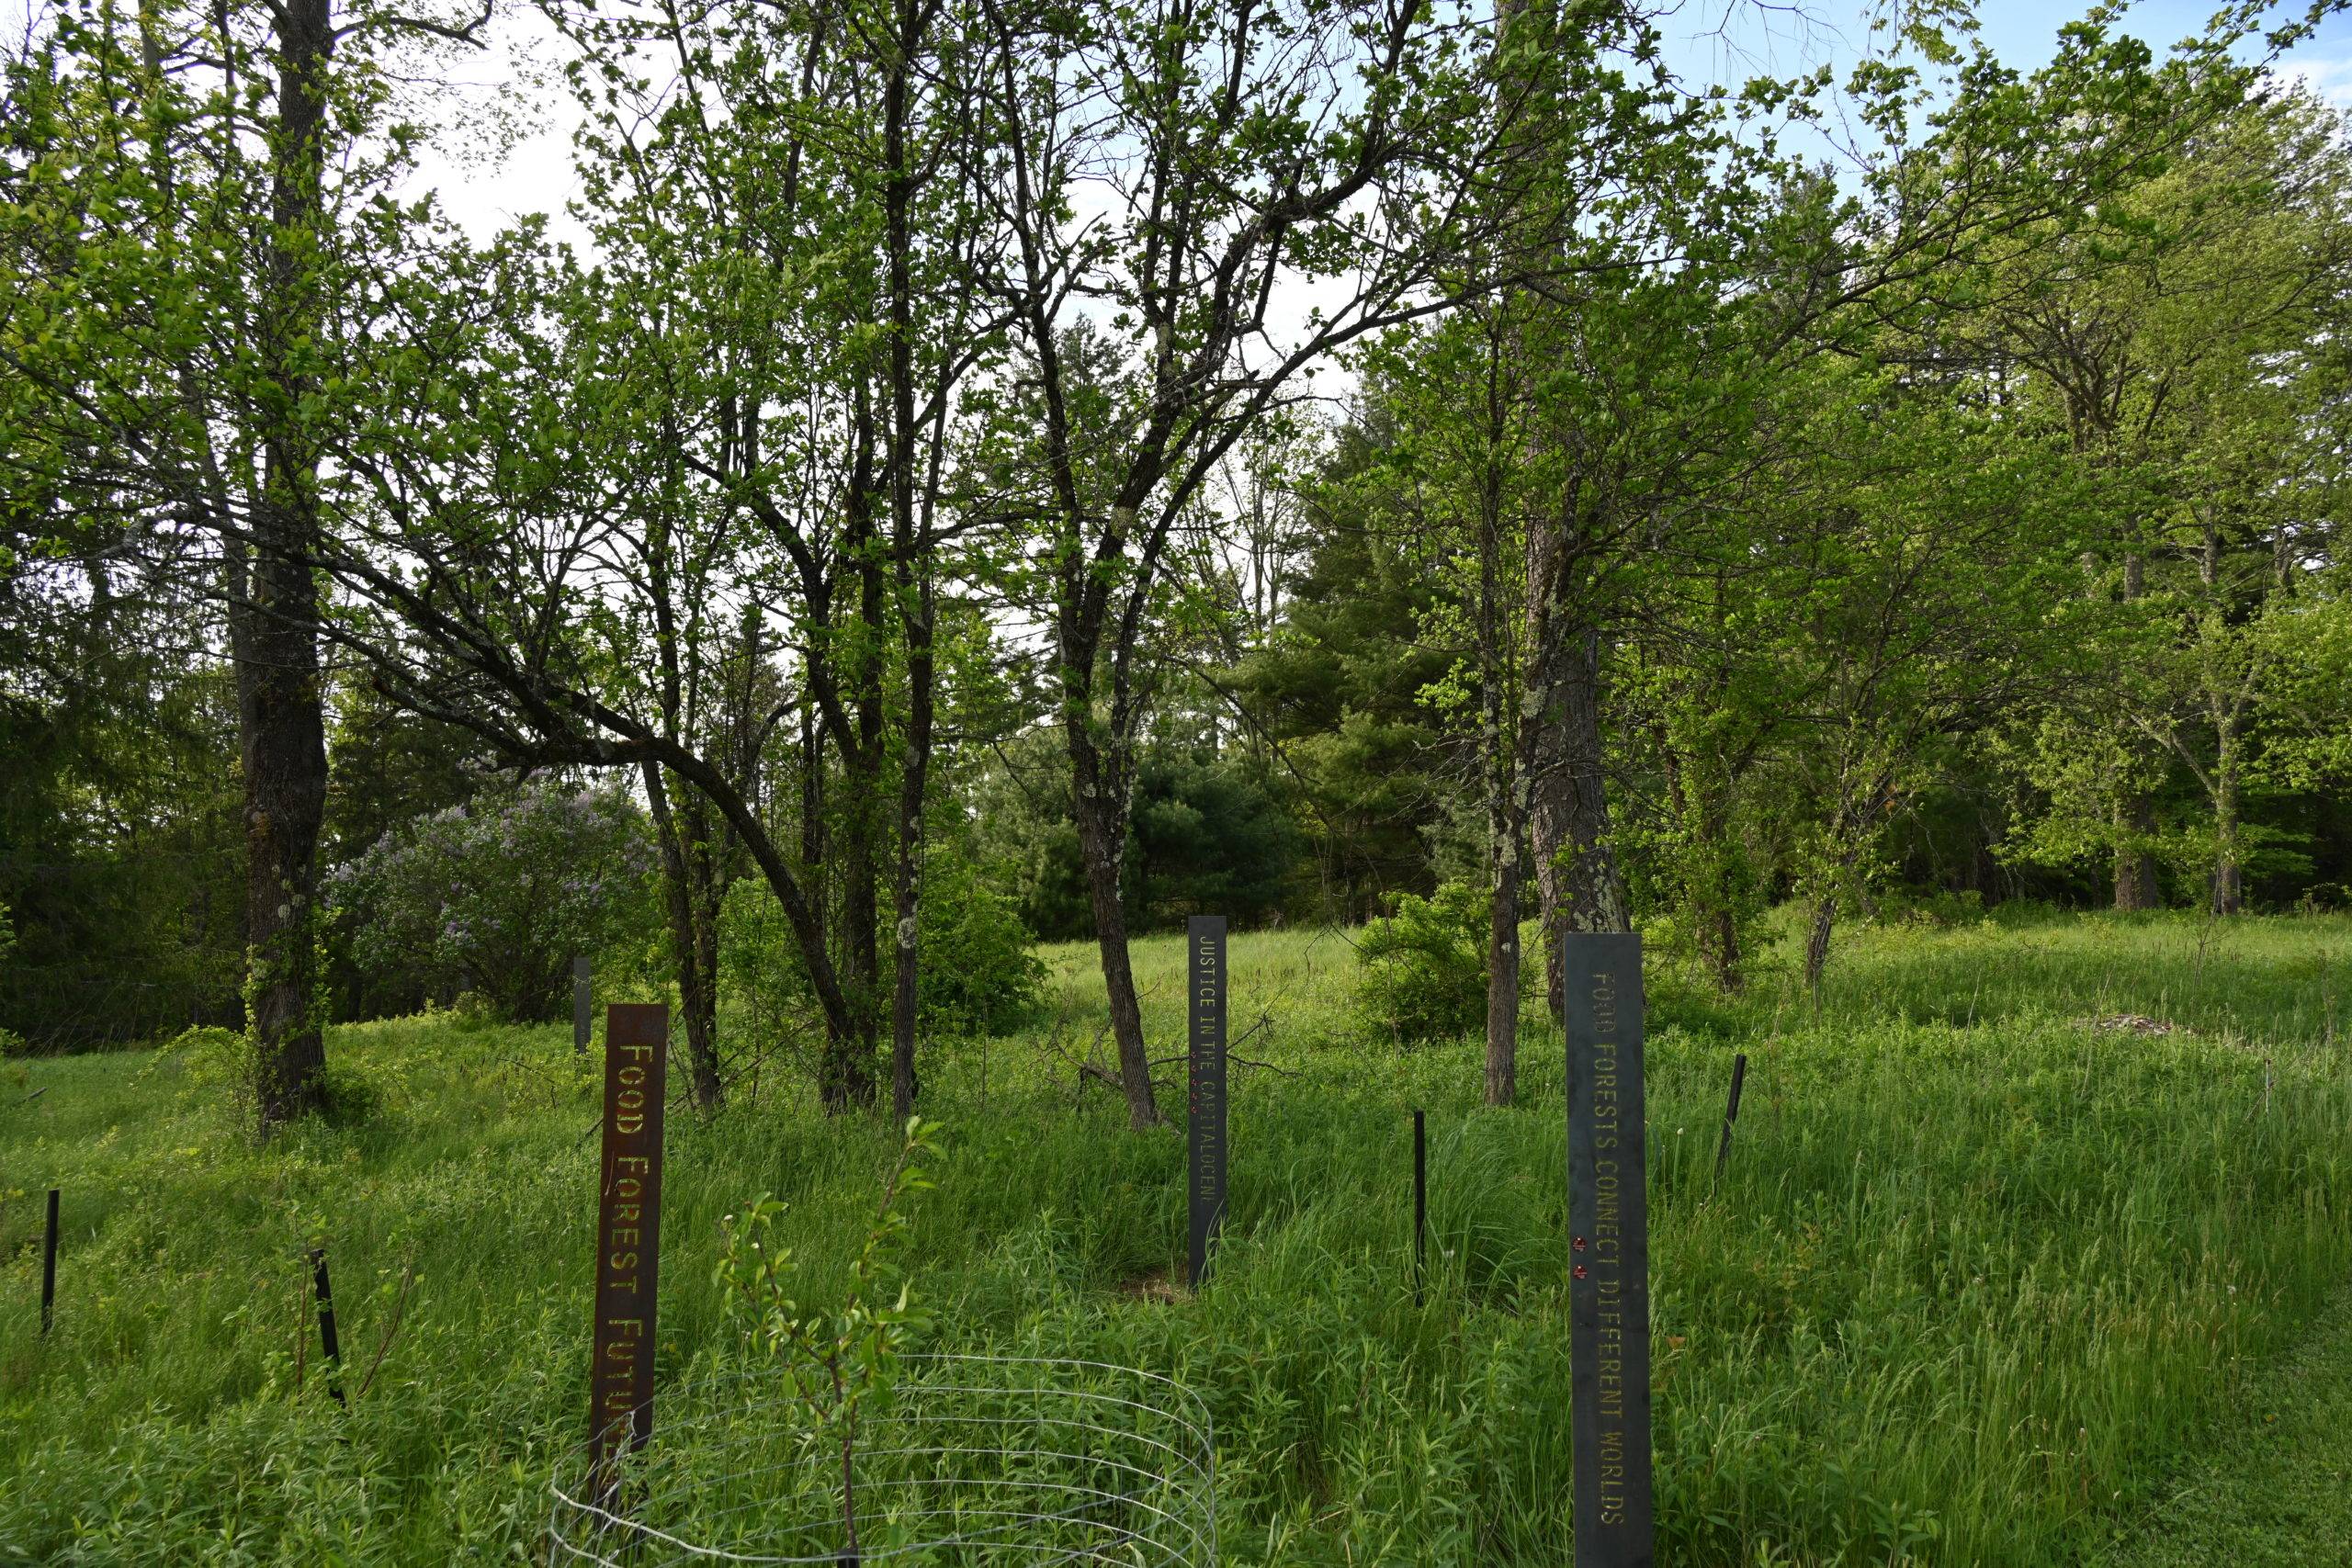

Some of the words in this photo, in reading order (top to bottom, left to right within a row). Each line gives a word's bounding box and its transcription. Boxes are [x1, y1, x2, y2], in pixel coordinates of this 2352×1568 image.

[1200, 936, 1216, 1008] JUSTICE
[1592, 974, 1616, 1034] FOOD
[1200, 1016, 1216, 1035] IN
[1200, 1043, 1216, 1071] THE
[616, 1045, 653, 1134] FOOD
[1594, 1043, 1619, 1148] FORESTS
[610, 1156, 649, 1294] FOREST
[1595, 1160, 1620, 1267] CONNECT
[1597, 1279, 1623, 1419] DIFFERENT
[1600, 1431, 1625, 1526] WORLDS
